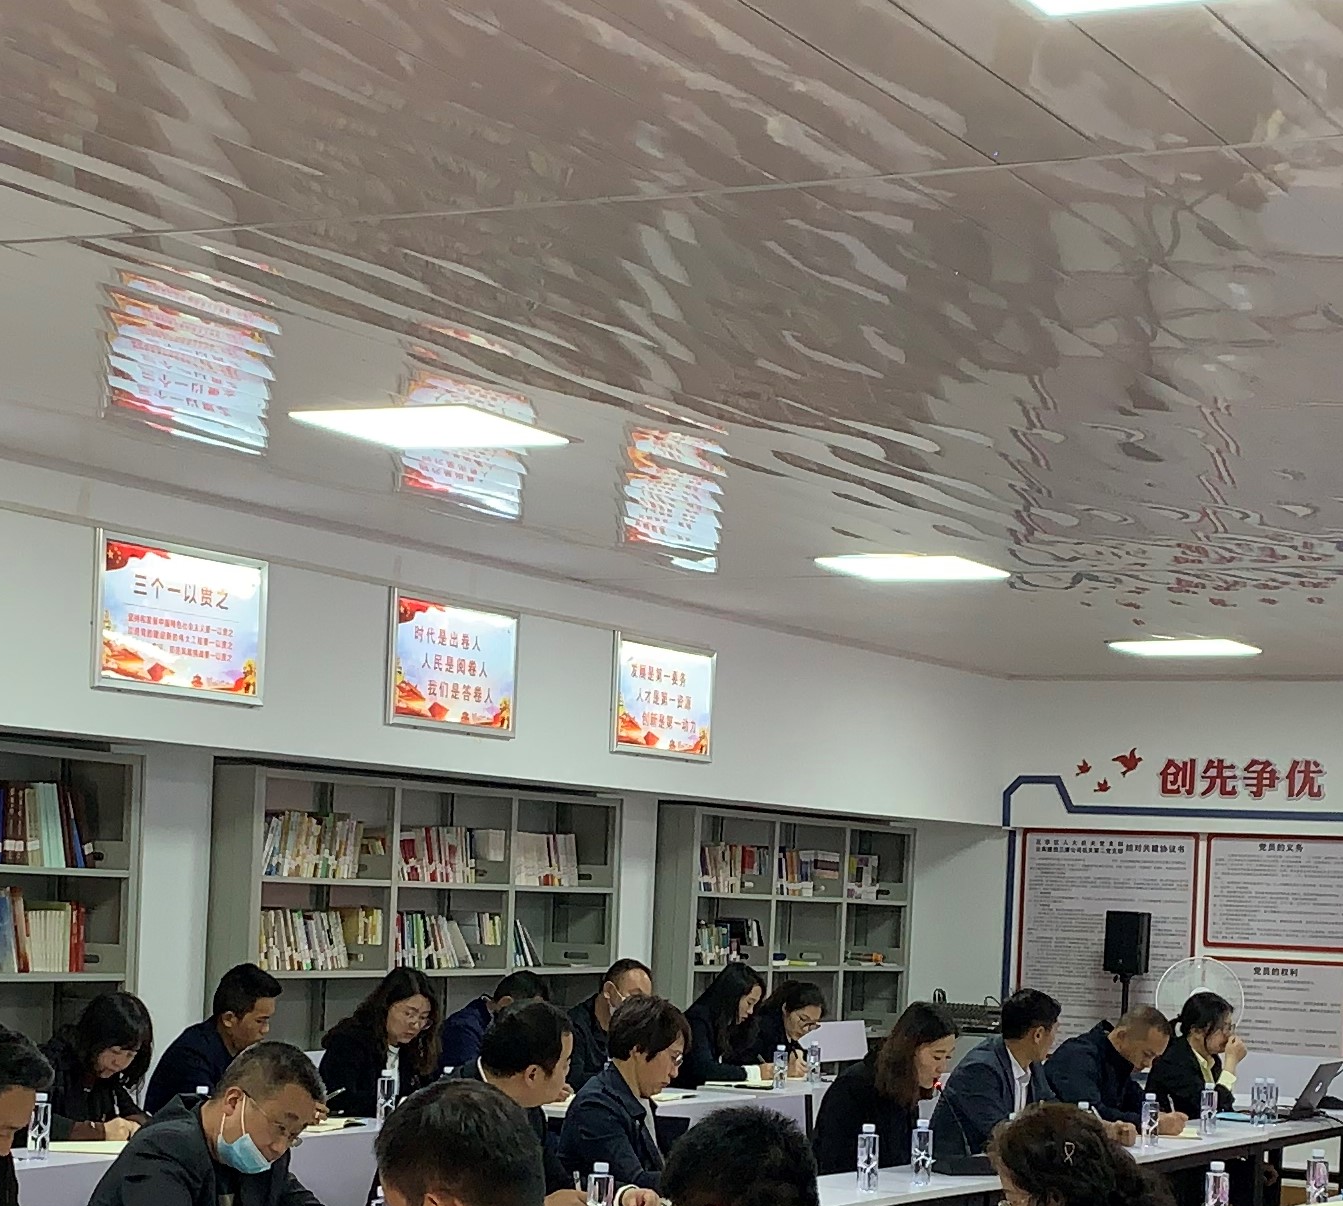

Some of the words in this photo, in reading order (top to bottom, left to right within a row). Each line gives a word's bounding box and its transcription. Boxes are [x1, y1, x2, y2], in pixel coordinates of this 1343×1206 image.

[133, 573, 229, 610] 三个一以贯之
[414, 625, 481, 652] 时代是出卷人
[422, 652, 488, 678] 人民是阅卷人
[630, 663, 687, 687] 发展是第一要务
[427, 679, 493, 704] 我们是答卷人
[1159, 758, 1325, 799] 创先争优
